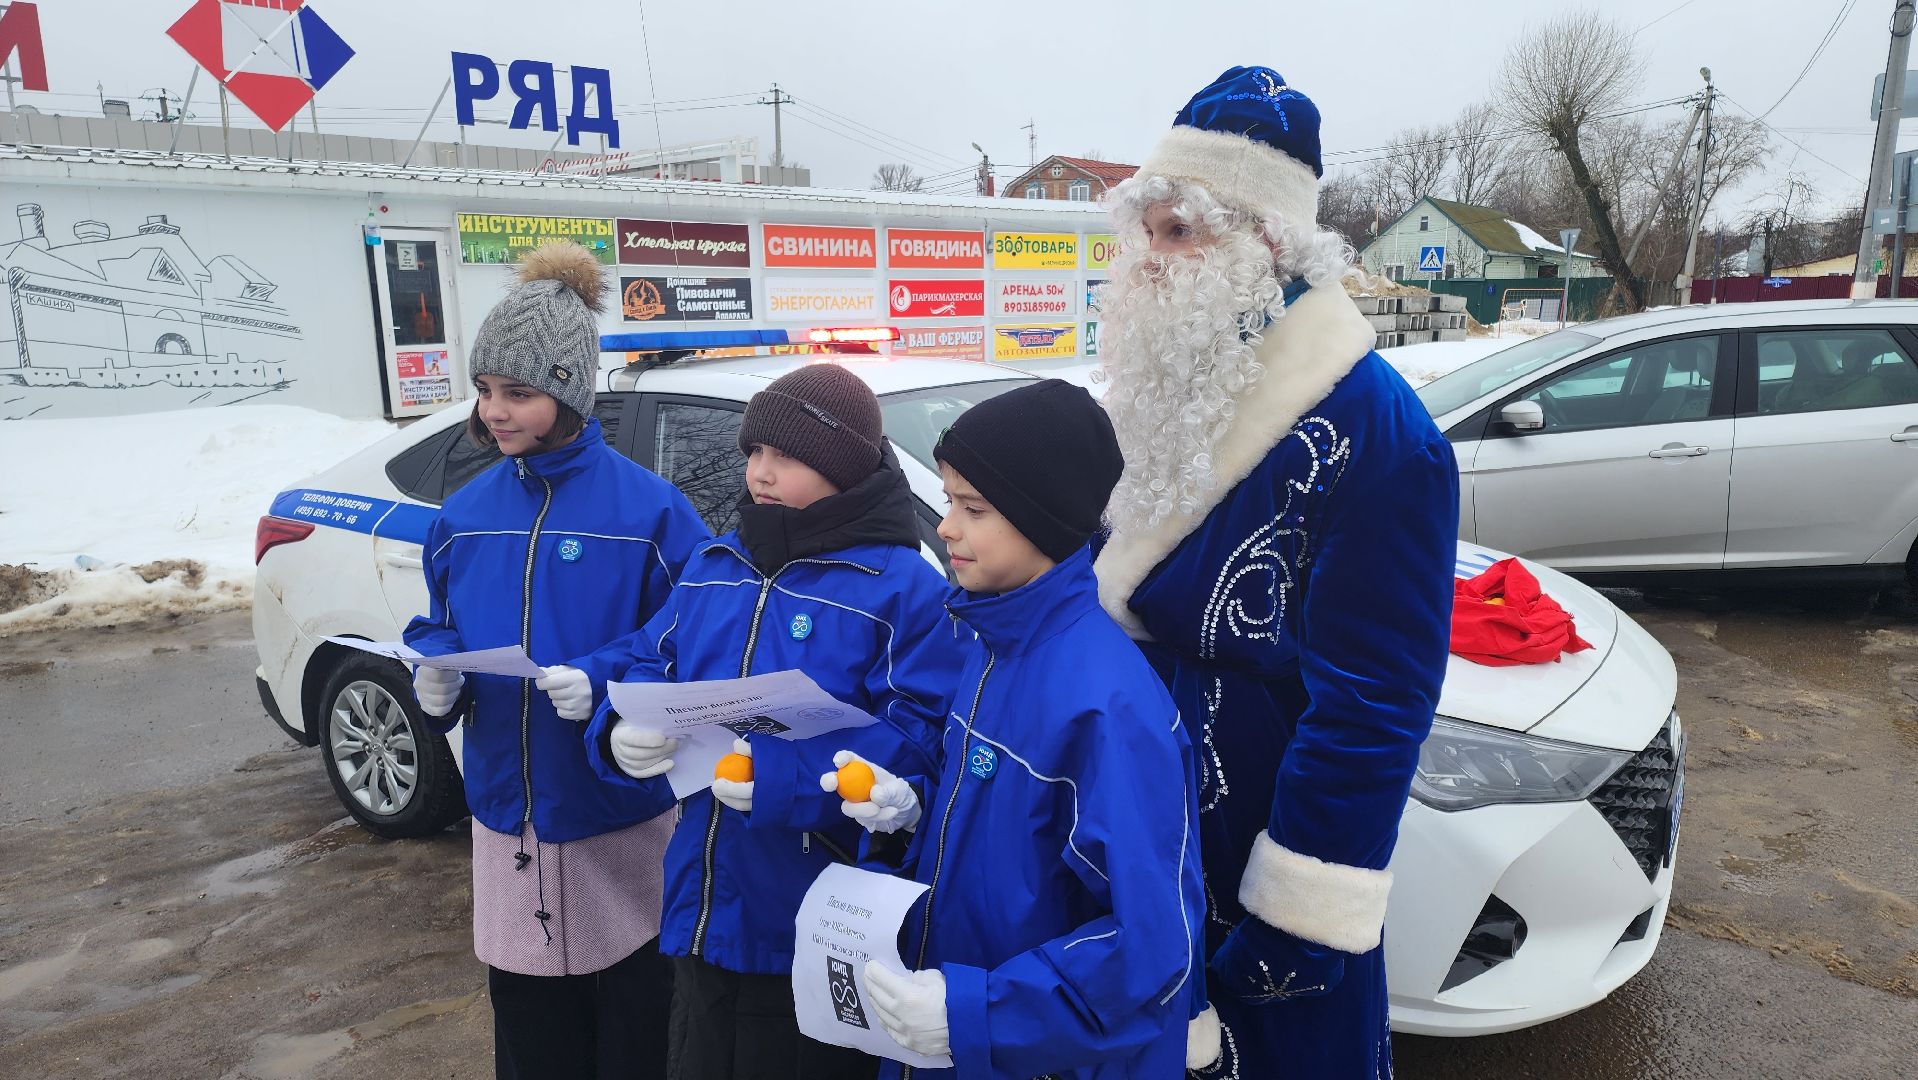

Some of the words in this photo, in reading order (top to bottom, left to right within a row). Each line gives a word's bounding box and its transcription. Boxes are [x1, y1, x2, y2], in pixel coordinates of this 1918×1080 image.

[451, 51, 620, 149] РЯД
[458, 214, 614, 236] ИНСТРУМЕНТЫ
[509, 236, 533, 247] ДЛЯ
[624, 231, 695, 251] Хмельная
[697, 239, 747, 256] кружка
[767, 236, 873, 257] СВИНИНА
[890, 239, 982, 259] ГОВЯДИНА
[996, 238, 1076, 255] ЗООТОВАРЫ
[911, 292, 983, 302] ПАРИКМАХЕРСКАЯ
[1002, 284, 1043, 296] АРЕНДА
[29, 295, 72, 311] КАШИРА
[770, 296, 874, 311] ЭНЕРГОГАРАНТ
[1004, 301, 1067, 312] 89031859069
[907, 332, 935, 348] ВАШ
[938, 330, 983, 347] ФЕРМЕР
[996, 345, 1076, 357] АВТОЗАПЧАСТИ
[403, 384, 447, 393] ИНСТРУМЕНТЫ
[301, 493, 336, 504] ТЕЛЕФОН
[334, 497, 372, 511] ДОВЕРИЯ
[294, 506, 313, 517] (495)
[665, 703, 709, 715] Письмо
[709, 695, 763, 710] водителю
[831, 960, 849, 977] ЮИД
